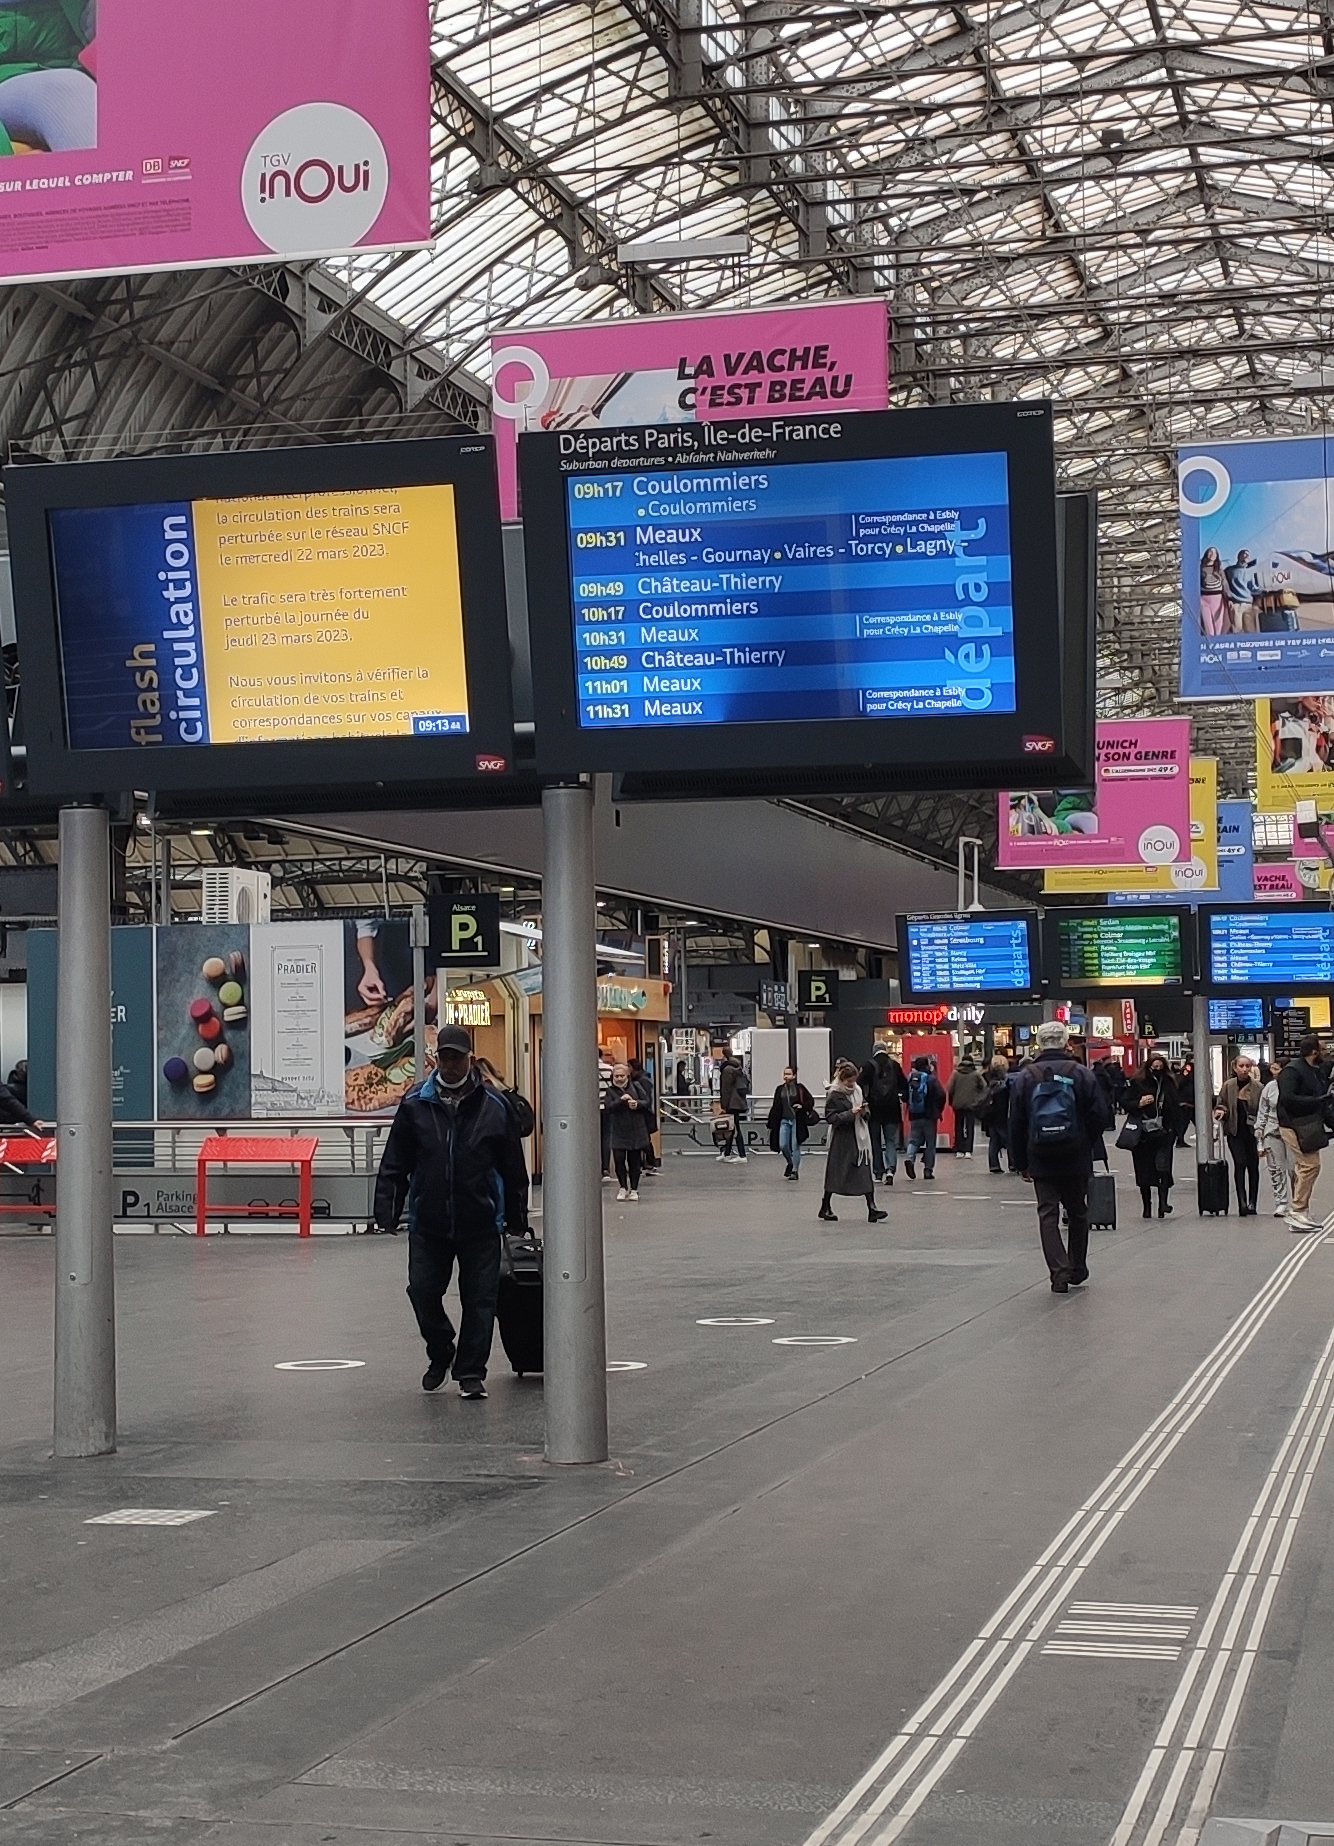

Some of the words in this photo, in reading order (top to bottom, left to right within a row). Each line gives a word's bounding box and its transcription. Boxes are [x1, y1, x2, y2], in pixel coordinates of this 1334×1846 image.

[261, 154, 291, 168] TGV
[26, 175, 70, 190] LEQUEL
[75, 171, 133, 185] COMPTER
[676, 354, 716, 381] LA
[723, 345, 837, 374] VACHE,
[677, 383, 765, 411] C'EST
[767, 375, 853, 403] BEAU
[560, 433, 638, 457] Départs
[645, 427, 698, 450] Paris,
[702, 421, 842, 447] Île-de-France
[560, 458, 608, 471] Suburban
[611, 457, 665, 468] departures
[675, 452, 714, 464] Abfahrt
[717, 449, 777, 461] Nahverkehr
[574, 482, 623, 498] 09h17
[633, 473, 768, 495] Coulommiers
[217, 511, 227, 524] la
[232, 508, 301, 523] circulation
[306, 506, 327, 519] des
[332, 503, 369, 516] trains
[373, 503, 400, 515] sera
[649, 497, 756, 517] Coulommiers
[929, 510, 934, 519] à
[219, 529, 282, 547] perturbée
[286, 530, 306, 541] sur
[311, 527, 321, 539] le
[326, 526, 367, 538] réseau
[373, 521, 409, 535] SNCF
[577, 531, 625, 548] 09h31
[636, 527, 702, 544] Meaux
[860, 526, 879, 537] pour
[907, 524, 916, 532] La
[702, 547, 771, 565] Gournay
[784, 542, 834, 559] Vaires
[848, 540, 892, 558] Torcy
[907, 538, 955, 556] Lagny
[580, 582, 623, 597] 09h49
[638, 573, 782, 595] Château-Thierry
[223, 594, 237, 607] Le
[242, 592, 276, 606] trafic
[280, 592, 306, 603] sera
[311, 589, 335, 601] très
[339, 587, 407, 600] fortement
[582, 607, 624, 622] 10h17
[639, 599, 758, 619] Coulommiers
[158, 514, 203, 744] circulation
[582, 631, 626, 646] 10h31
[641, 627, 699, 644] Meaux
[584, 656, 627, 670] 10h49
[642, 647, 785, 668] Château-Thierry
[230, 675, 262, 688] Nous
[266, 674, 296, 686] vous
[300, 671, 352, 684] invitons
[356, 669, 363, 681] à
[367, 667, 413, 682] vérifier
[416, 667, 428, 678] la
[585, 681, 627, 694] 11h01
[644, 676, 701, 693] Meaux
[126, 642, 163, 745] flash
[586, 704, 629, 719] 11h31
[644, 700, 702, 717] Meaux
[418, 719, 449, 732] 09:13
[1097, 739, 1138, 750] UNICH
[478, 760, 504, 770] SNCF
[1104, 751, 1130, 762] SON
[1134, 750, 1176, 761] GENRE
[277, 963, 316, 974] PRADIER
[156, 1202, 194, 1213] Alsace
